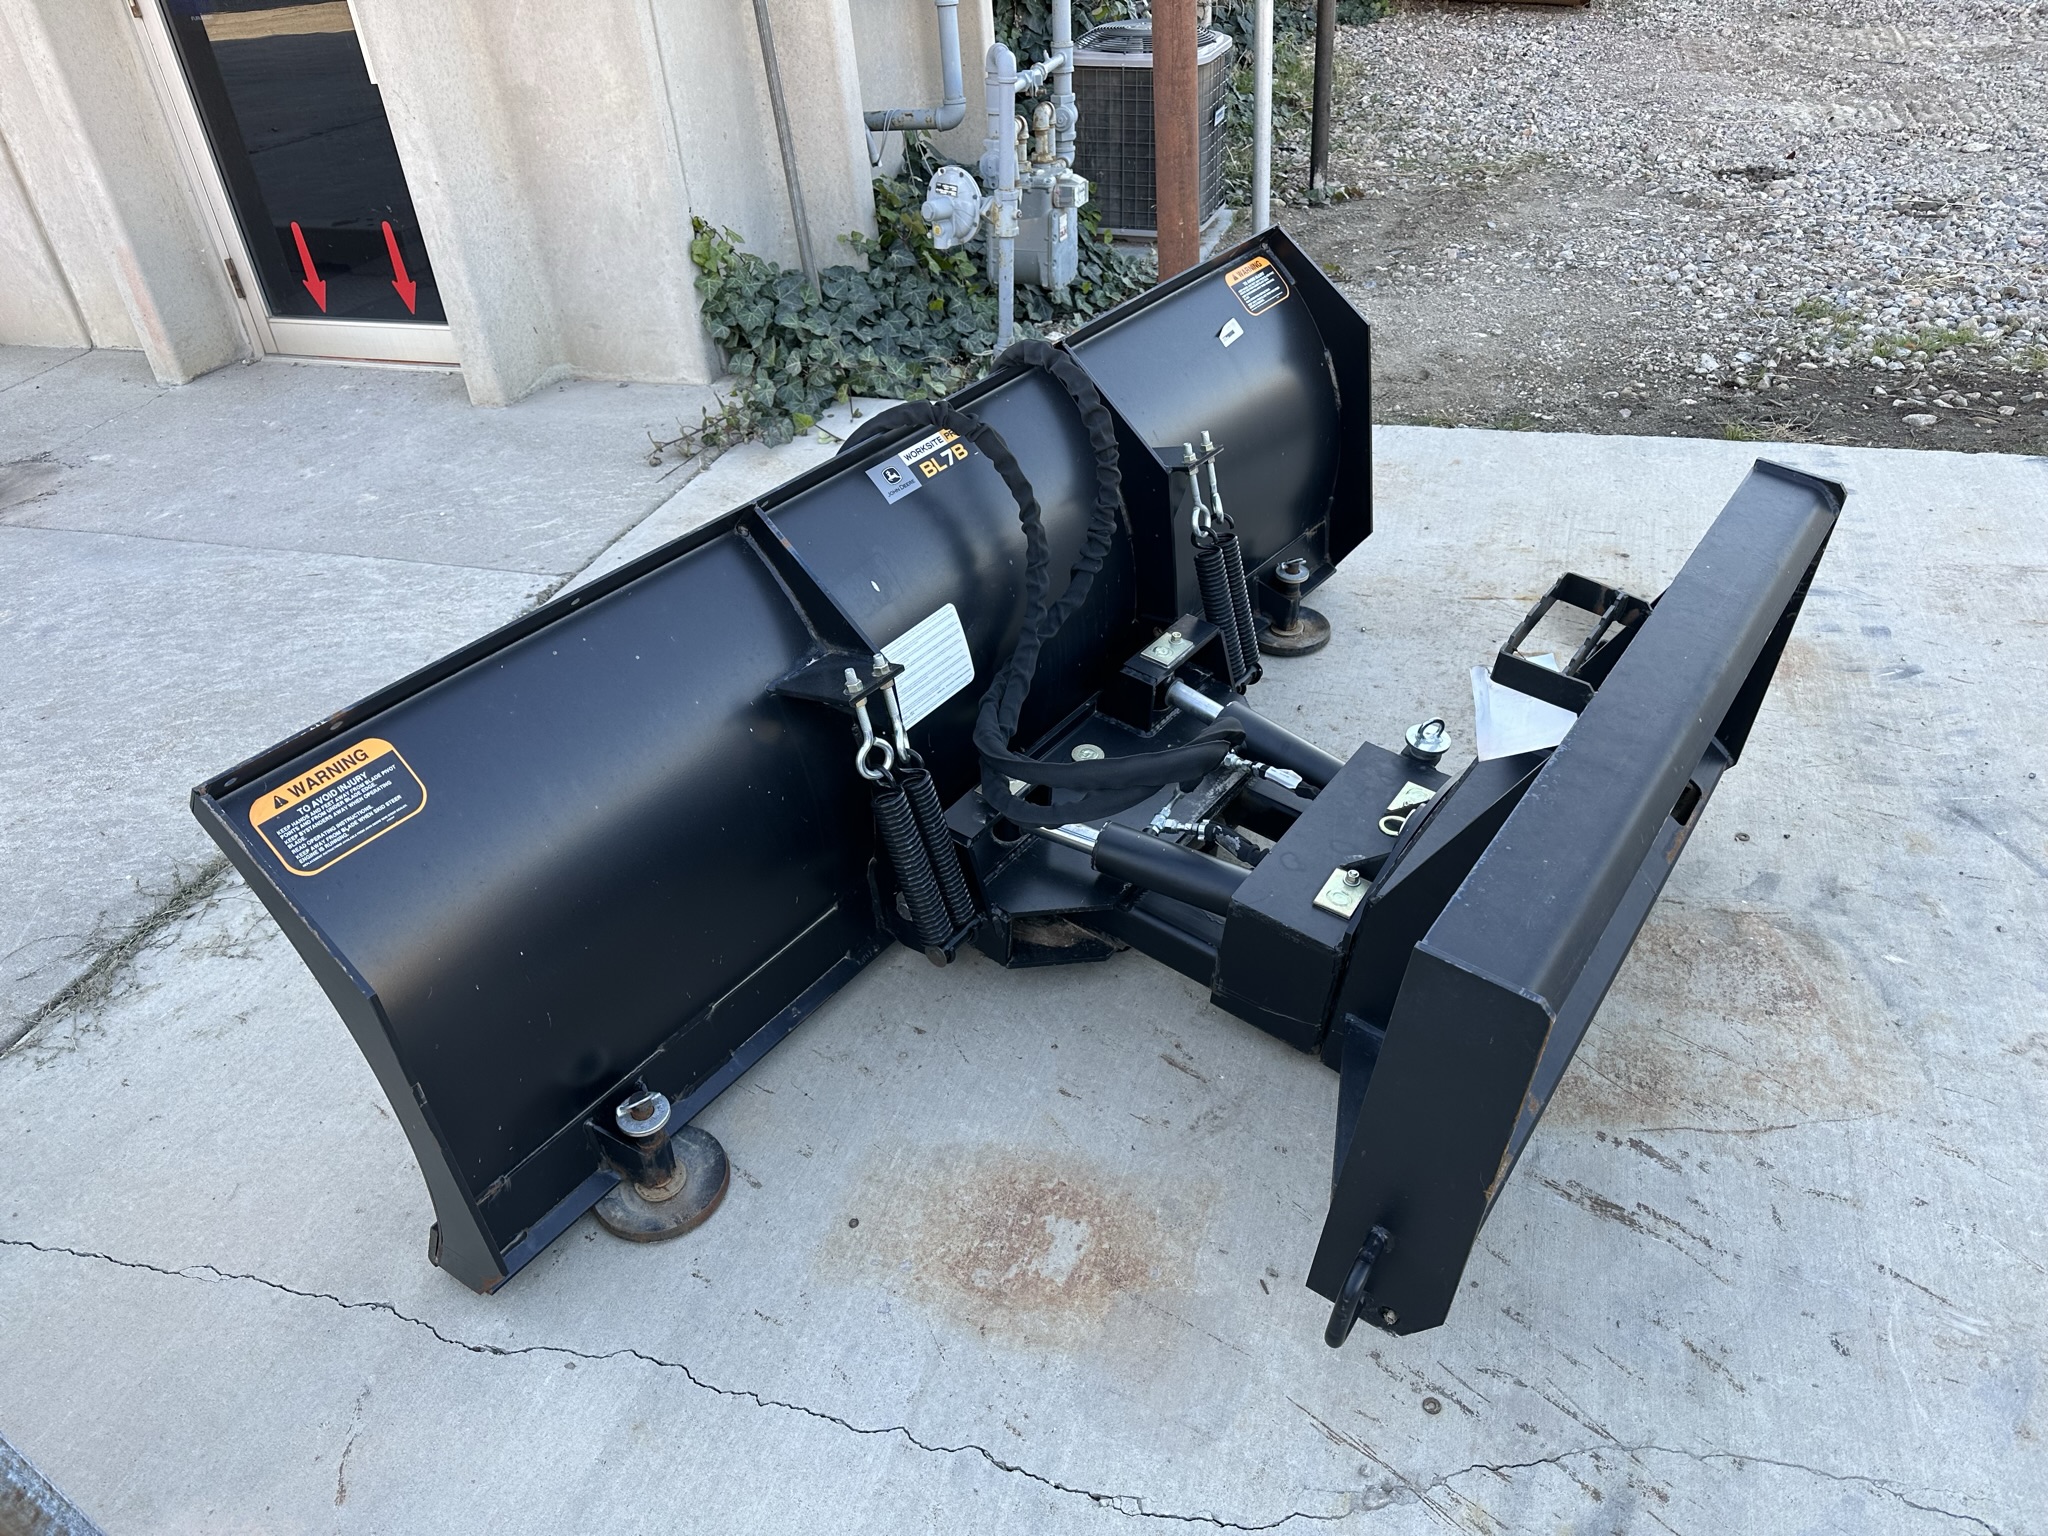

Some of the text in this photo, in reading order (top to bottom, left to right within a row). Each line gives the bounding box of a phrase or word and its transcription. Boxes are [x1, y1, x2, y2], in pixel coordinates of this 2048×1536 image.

[903, 435, 944, 462] WORKSITE
[919, 443, 969, 479] BL7B
[887, 479, 916, 498] JOHN DEERE
[286, 749, 369, 798] WARNING
[296, 771, 368, 815] TO AVOID INJURY
[276, 764, 396, 836] KEEP HANDS AND FEET AWAY FROM BLADE PIVOT
[279, 782, 378, 840] POINTS AND FROM UNDER BLADE EDGE.
[283, 780, 392, 845] KEEP BYSTANDERS AWAY WHEN OPERATING
[287, 836, 308, 850] BLADE.
[291, 843, 307, 855] READ
[306, 825, 337, 846] OPERATING
[335, 804, 374, 829] INSTRUCTIONS.
[295, 848, 310, 860] KEEP
[310, 838, 326, 851] AWAY
[325, 830, 342, 842] FROM
[340, 819, 359, 833] BLADE
[357, 811, 374, 823] WHEN
[372, 804, 386, 814] SKID
[384, 794, 402, 807] STEER
[298, 849, 320, 864] ENGINE
[323, 832, 350, 849] RUNNING.
